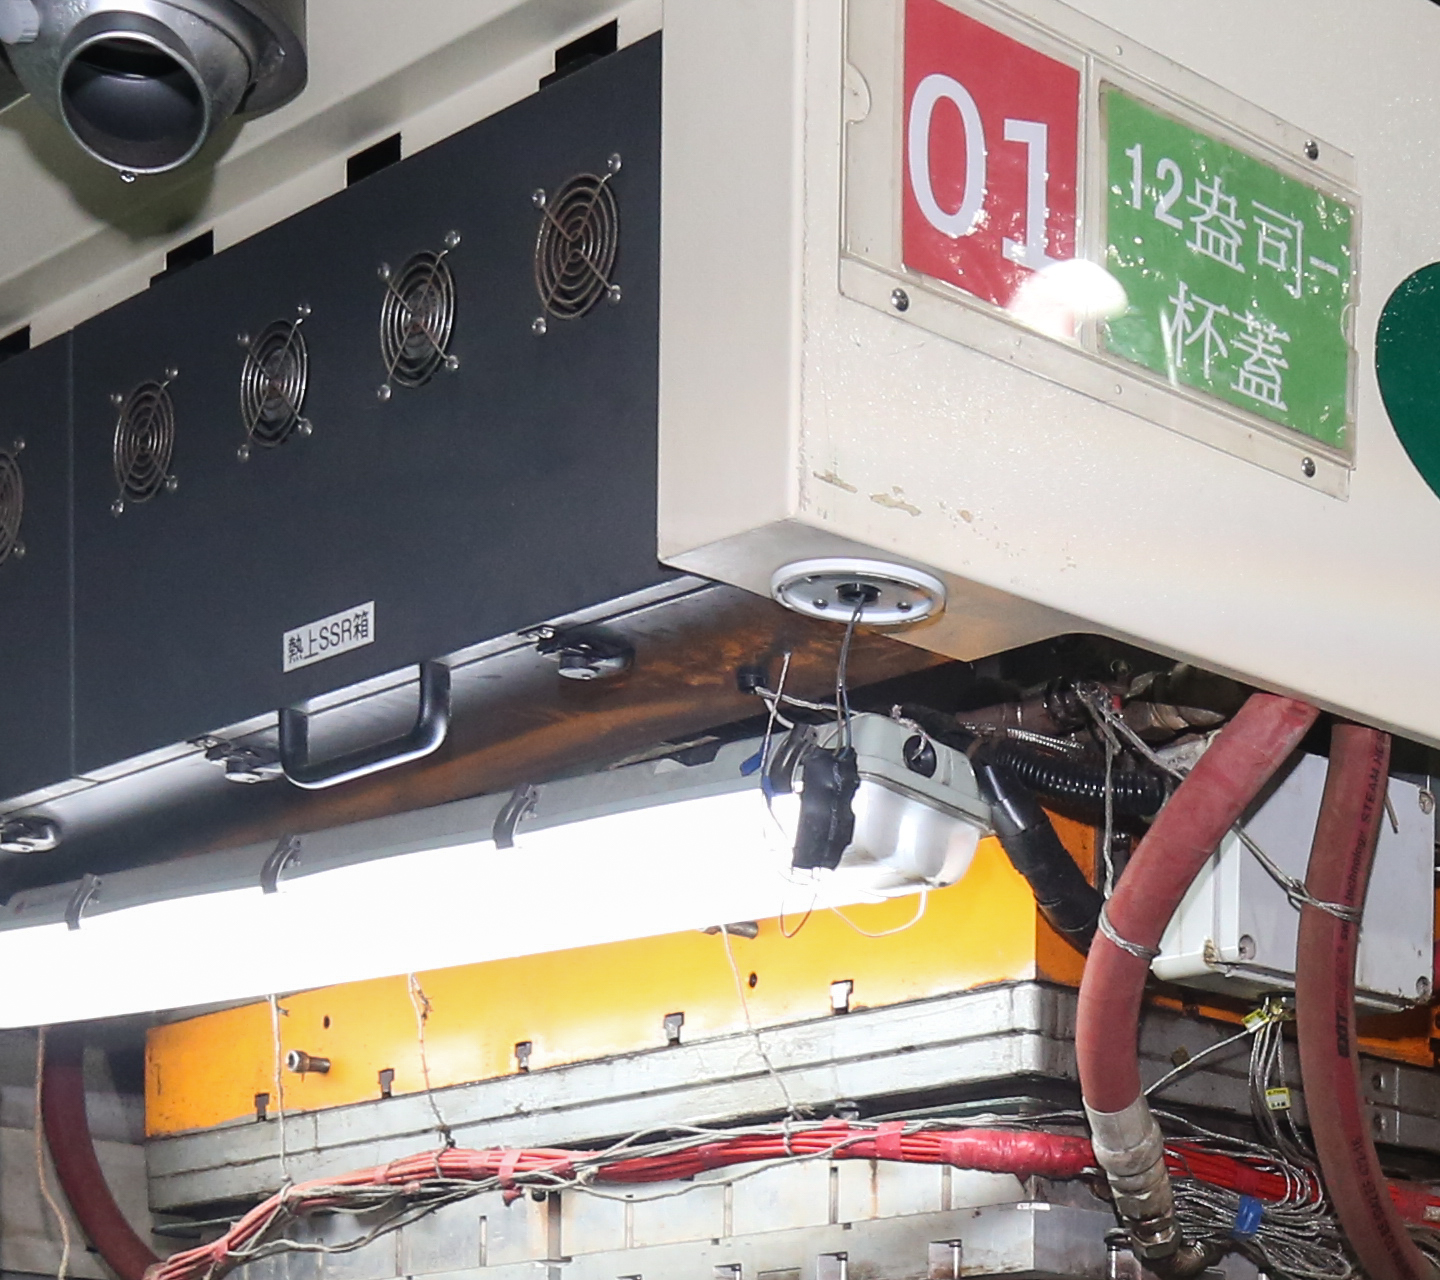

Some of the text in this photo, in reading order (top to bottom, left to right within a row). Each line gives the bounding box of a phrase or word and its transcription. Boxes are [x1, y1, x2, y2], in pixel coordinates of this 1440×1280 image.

[909, 73, 1069, 273] 01
[1165, 279, 1291, 412] 杯蓋
[288, 610, 369, 663] 熱上SSR箱
